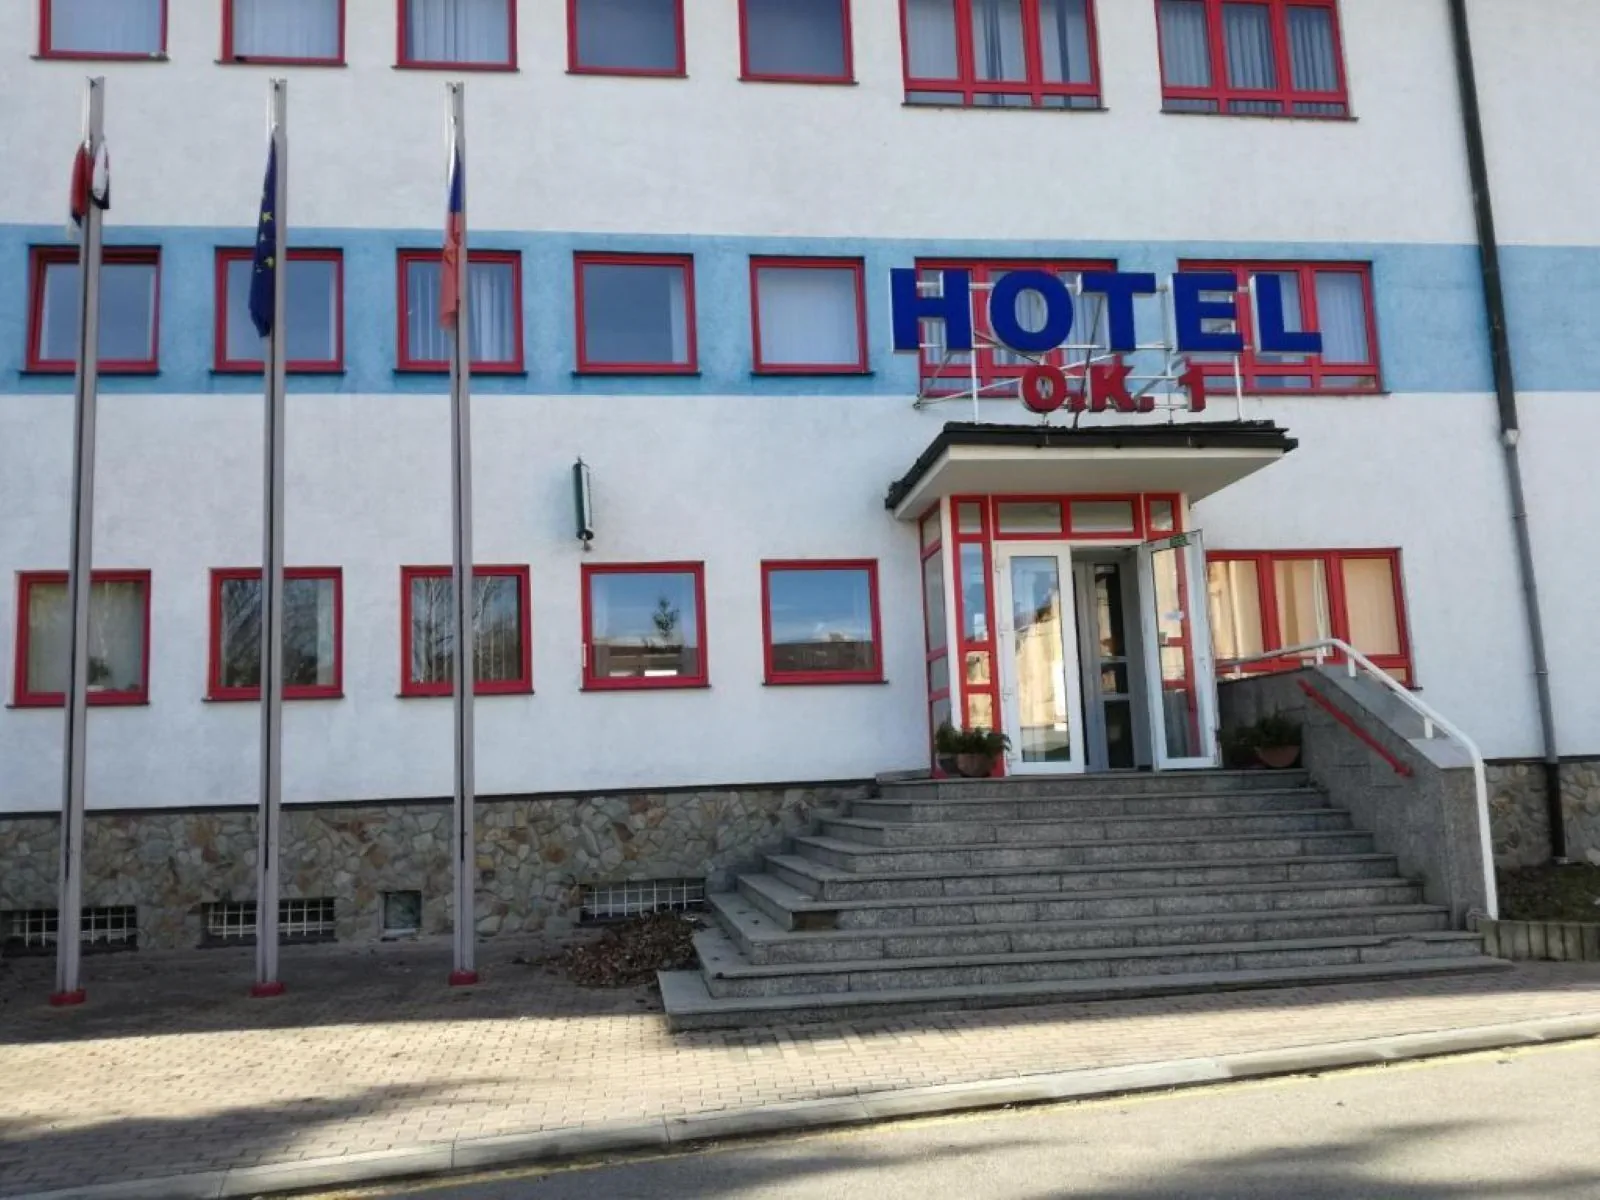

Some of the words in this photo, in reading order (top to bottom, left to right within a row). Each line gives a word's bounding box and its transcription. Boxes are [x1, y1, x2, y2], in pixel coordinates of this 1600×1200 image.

[891, 267, 1322, 353] HOTEL
[1021, 364, 1155, 413] O.K.
[1178, 366, 1206, 412] 1
